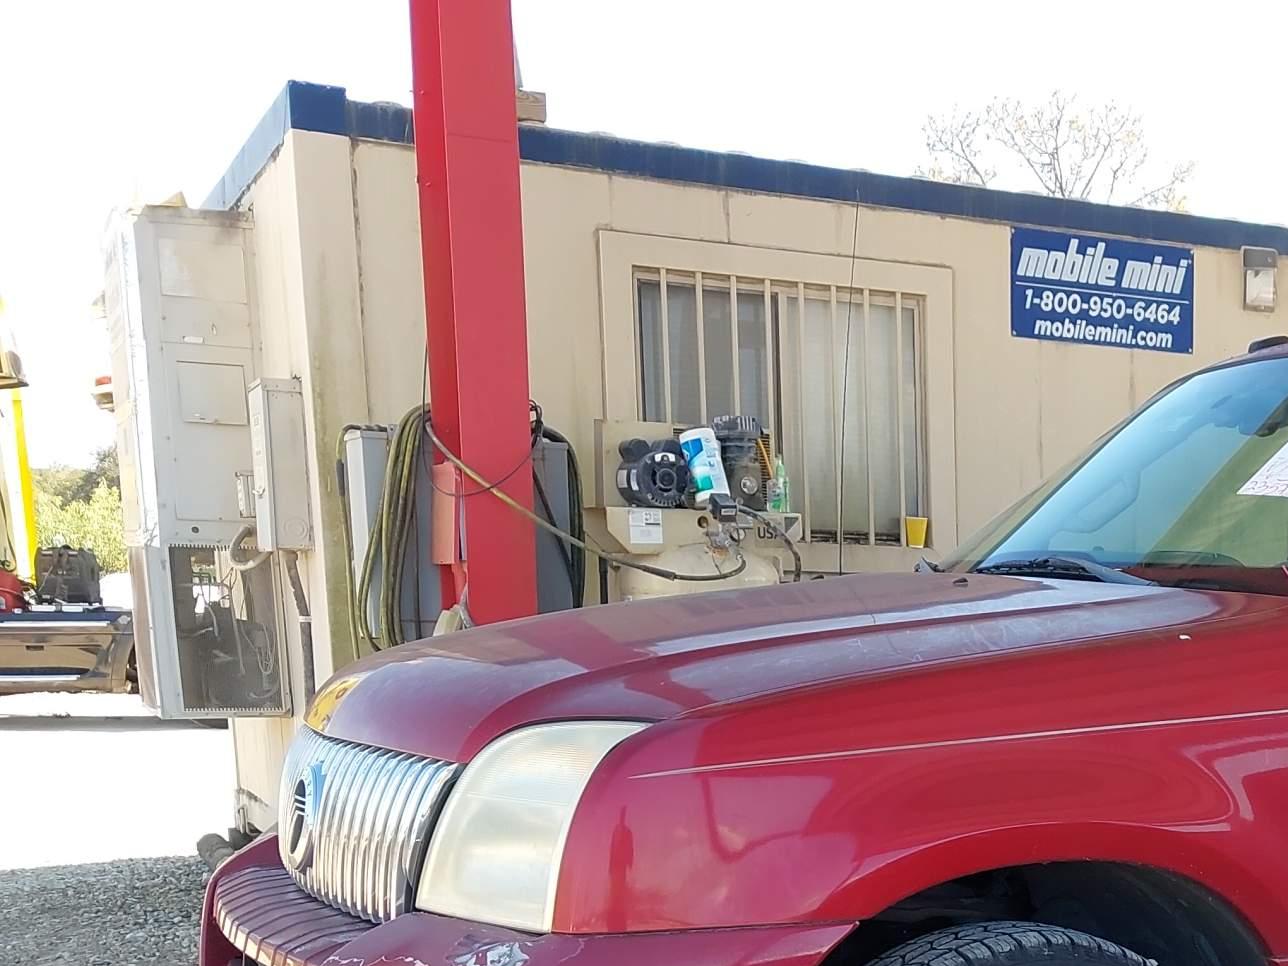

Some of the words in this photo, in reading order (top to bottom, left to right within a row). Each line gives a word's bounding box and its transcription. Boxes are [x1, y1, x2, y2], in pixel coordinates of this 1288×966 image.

[1016, 238, 1120, 287] mobile
[1121, 256, 1190, 295] mini
[1025, 289, 1181, 326] 1-800-950-6464
[1034, 318, 1173, 348] mobilemini.com
[757, 526, 780, 540] US
